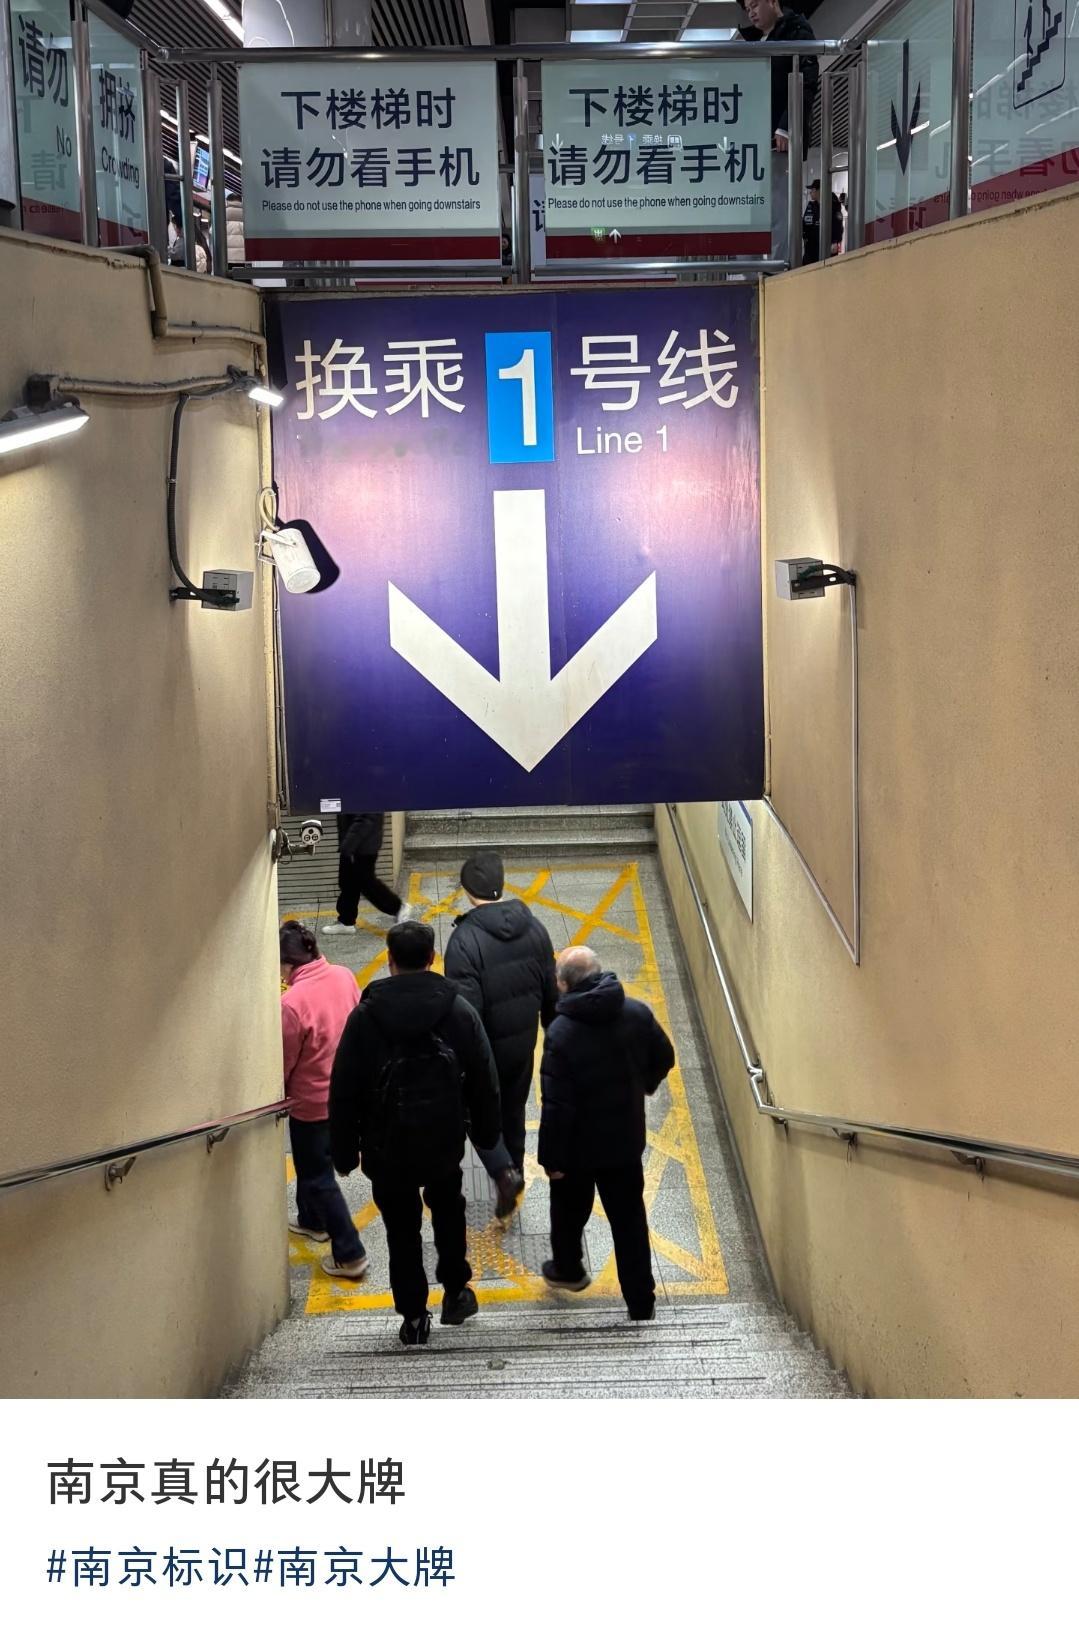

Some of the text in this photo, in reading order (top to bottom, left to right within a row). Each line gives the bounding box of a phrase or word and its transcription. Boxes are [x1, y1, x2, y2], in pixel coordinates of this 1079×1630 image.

[18, 14, 136, 144] 请勿 拥挤
[281, 87, 456, 130] 下楼梯时
[568, 83, 743, 127] 下楼梯时
[56, 125, 72, 158] No
[260, 146, 480, 189] 请勿看手机
[547, 142, 766, 186] 请勿看手机
[262, 199, 481, 212] Please do not use the phone when going downstairs
[548, 194, 765, 209] Please do not use the phone when going downstairs
[295, 329, 739, 446] 换乘 1 号线
[576, 424, 669, 455] Line 1
